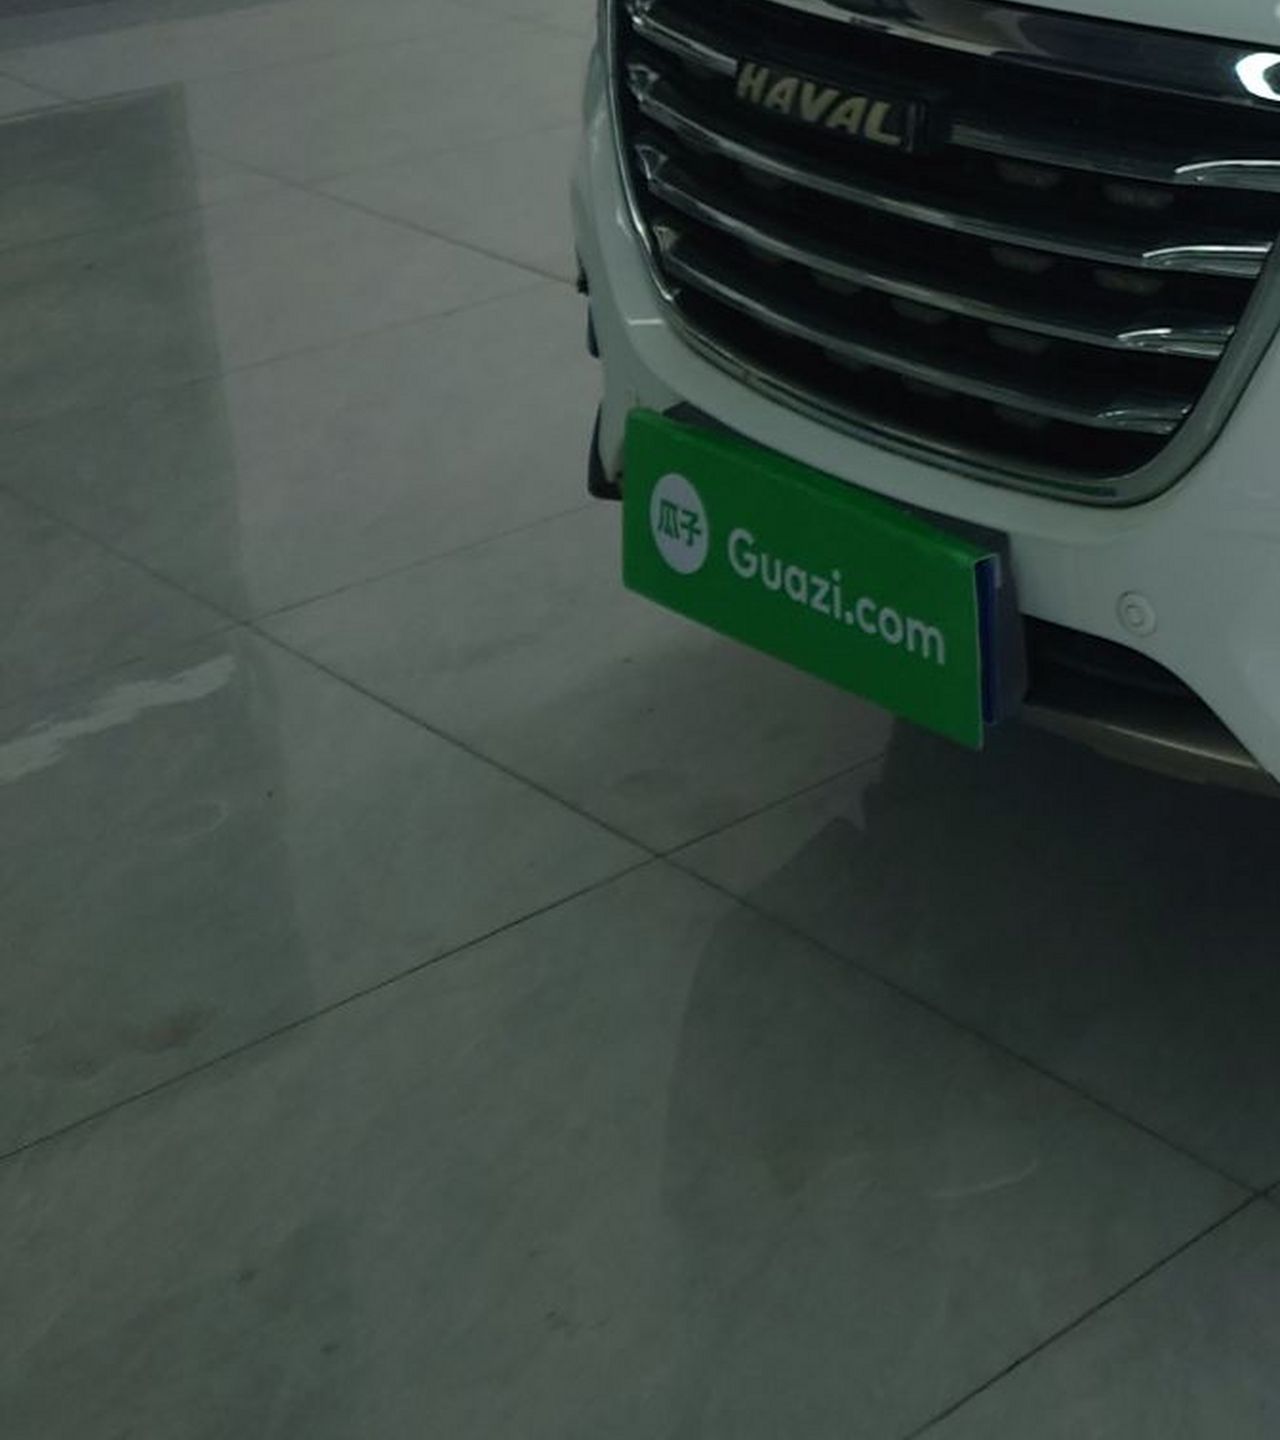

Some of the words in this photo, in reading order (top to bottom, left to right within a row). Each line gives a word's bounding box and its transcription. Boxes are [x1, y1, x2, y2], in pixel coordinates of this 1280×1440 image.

[736, 62, 901, 146] HAVAL
[657, 499, 702, 547] 瓜子
[727, 527, 946, 665] Guazi.com
